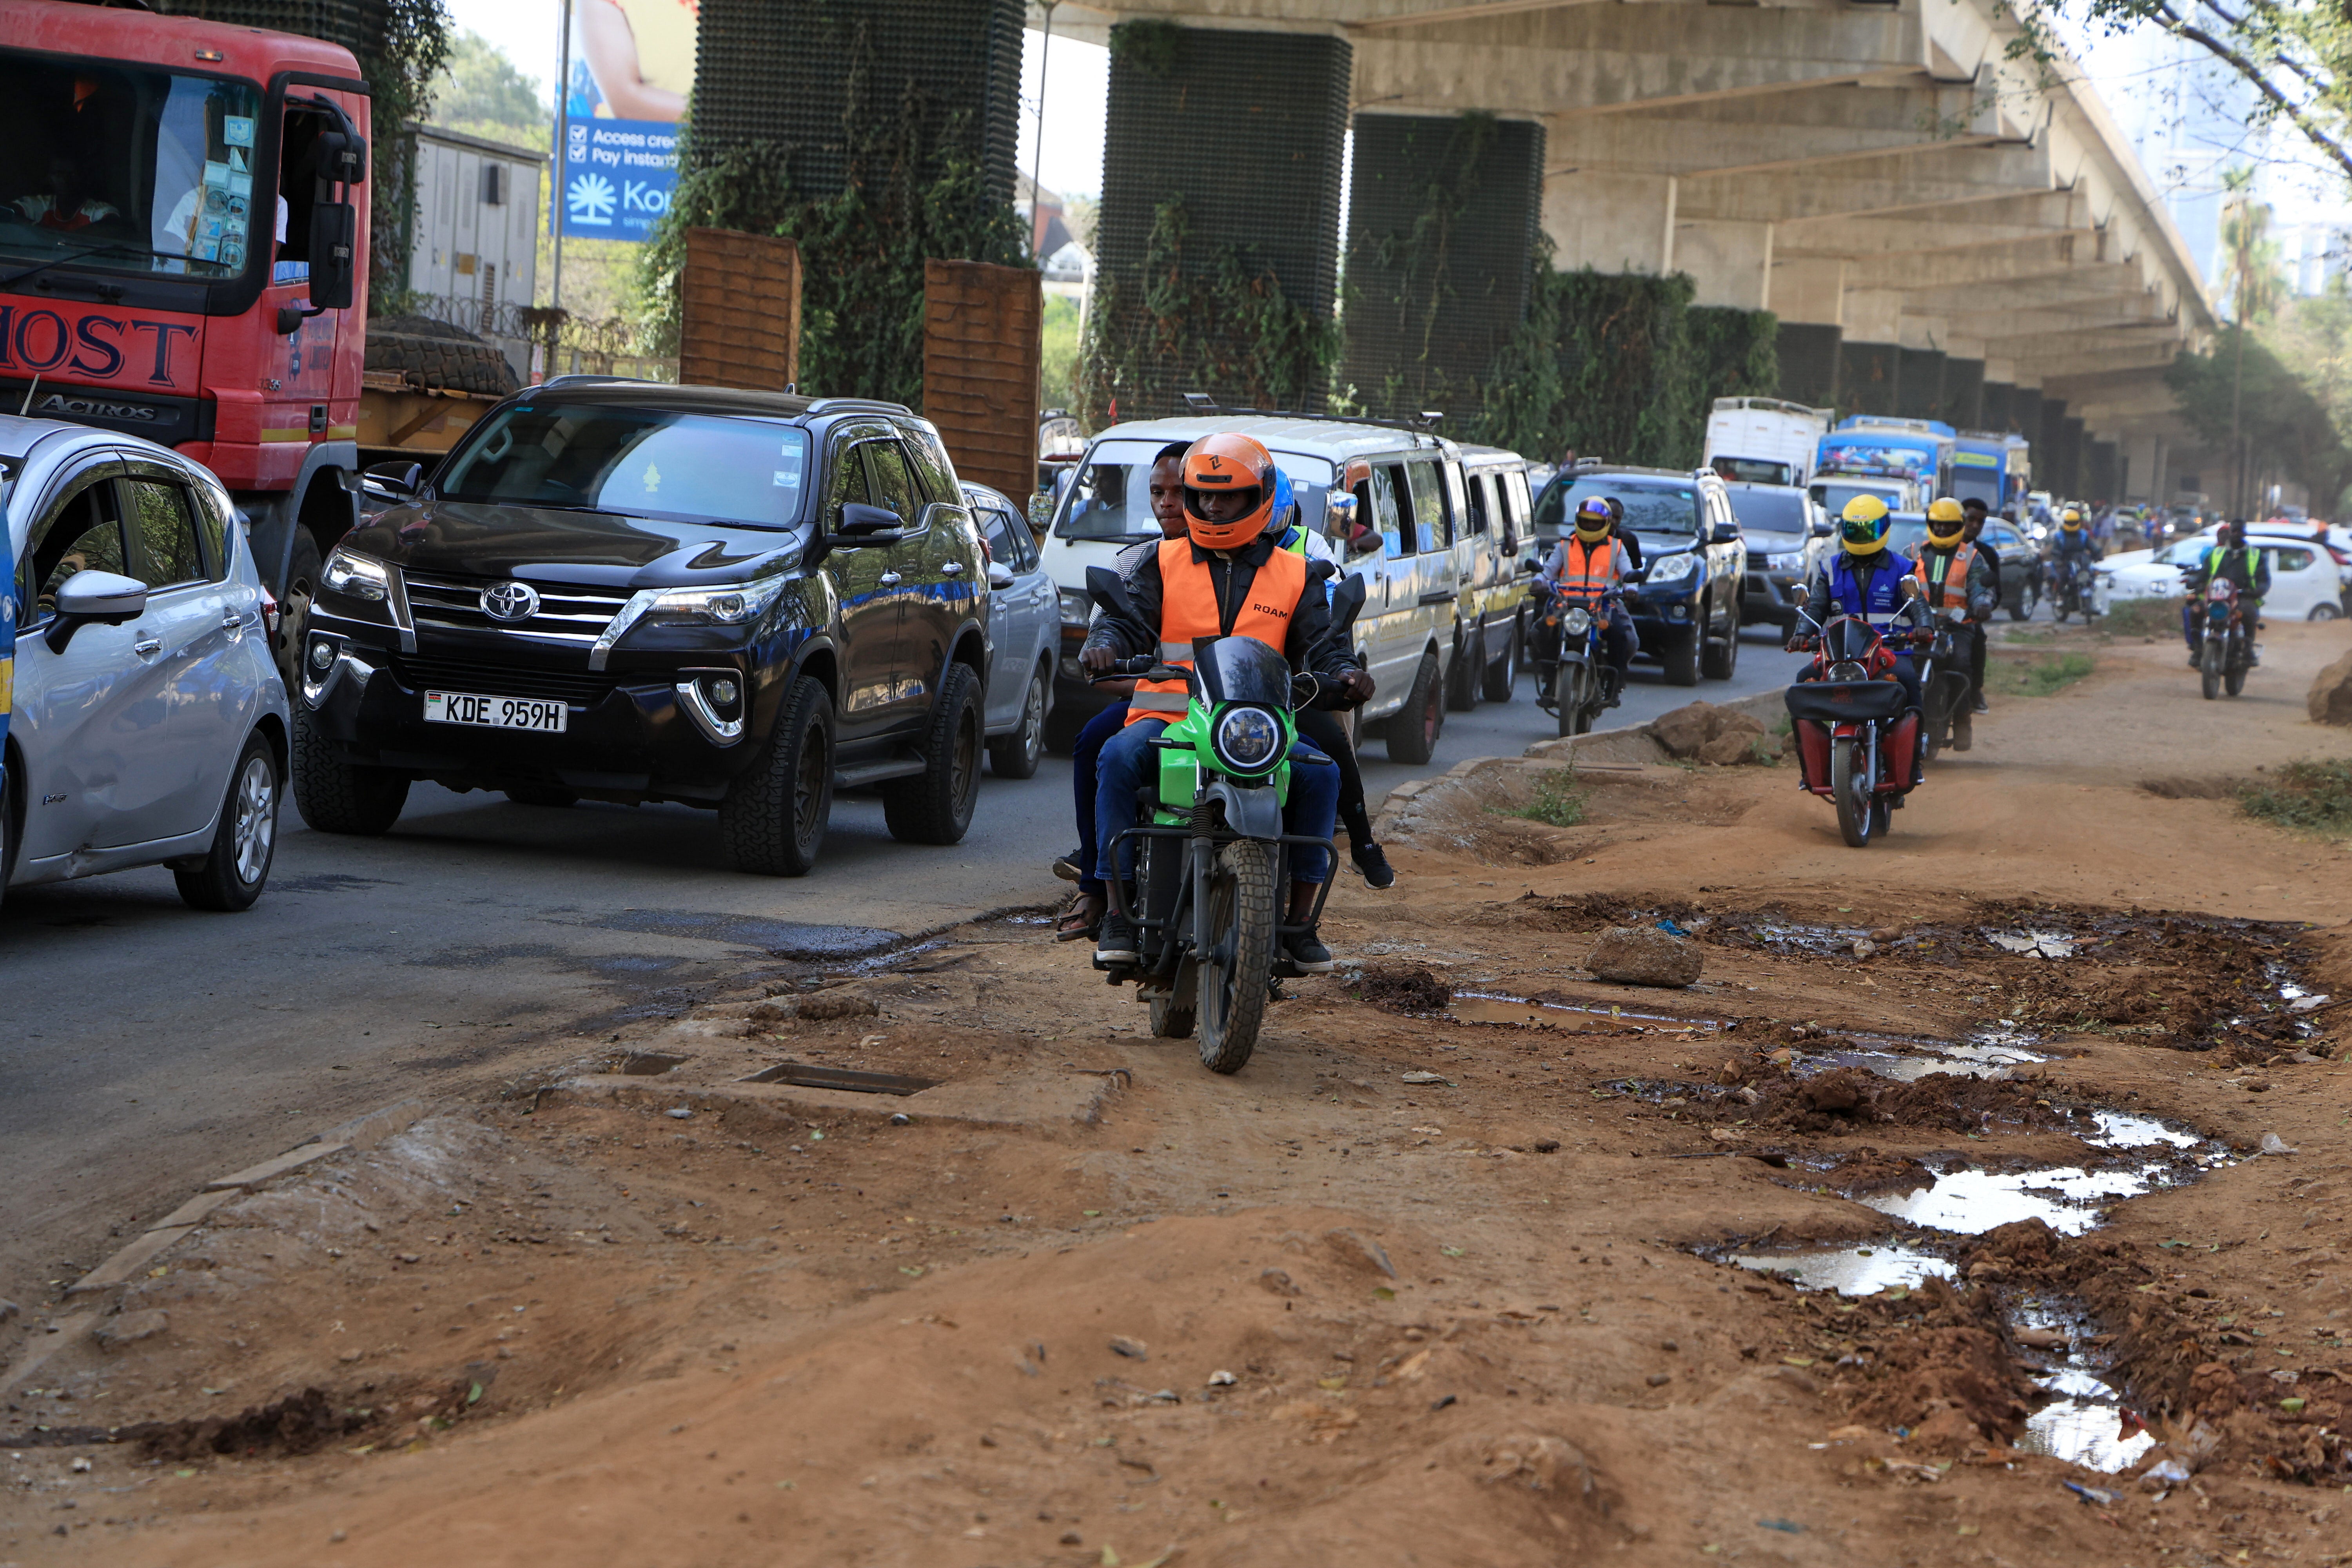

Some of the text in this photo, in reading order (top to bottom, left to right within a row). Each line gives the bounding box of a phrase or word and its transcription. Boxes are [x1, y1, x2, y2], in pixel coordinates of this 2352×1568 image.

[592, 129, 646, 147] Access
[592, 147, 621, 168] Pay
[1254, 603, 1288, 620] ROAM
[446, 695, 491, 723] KDE
[502, 701, 559, 730] 959H
